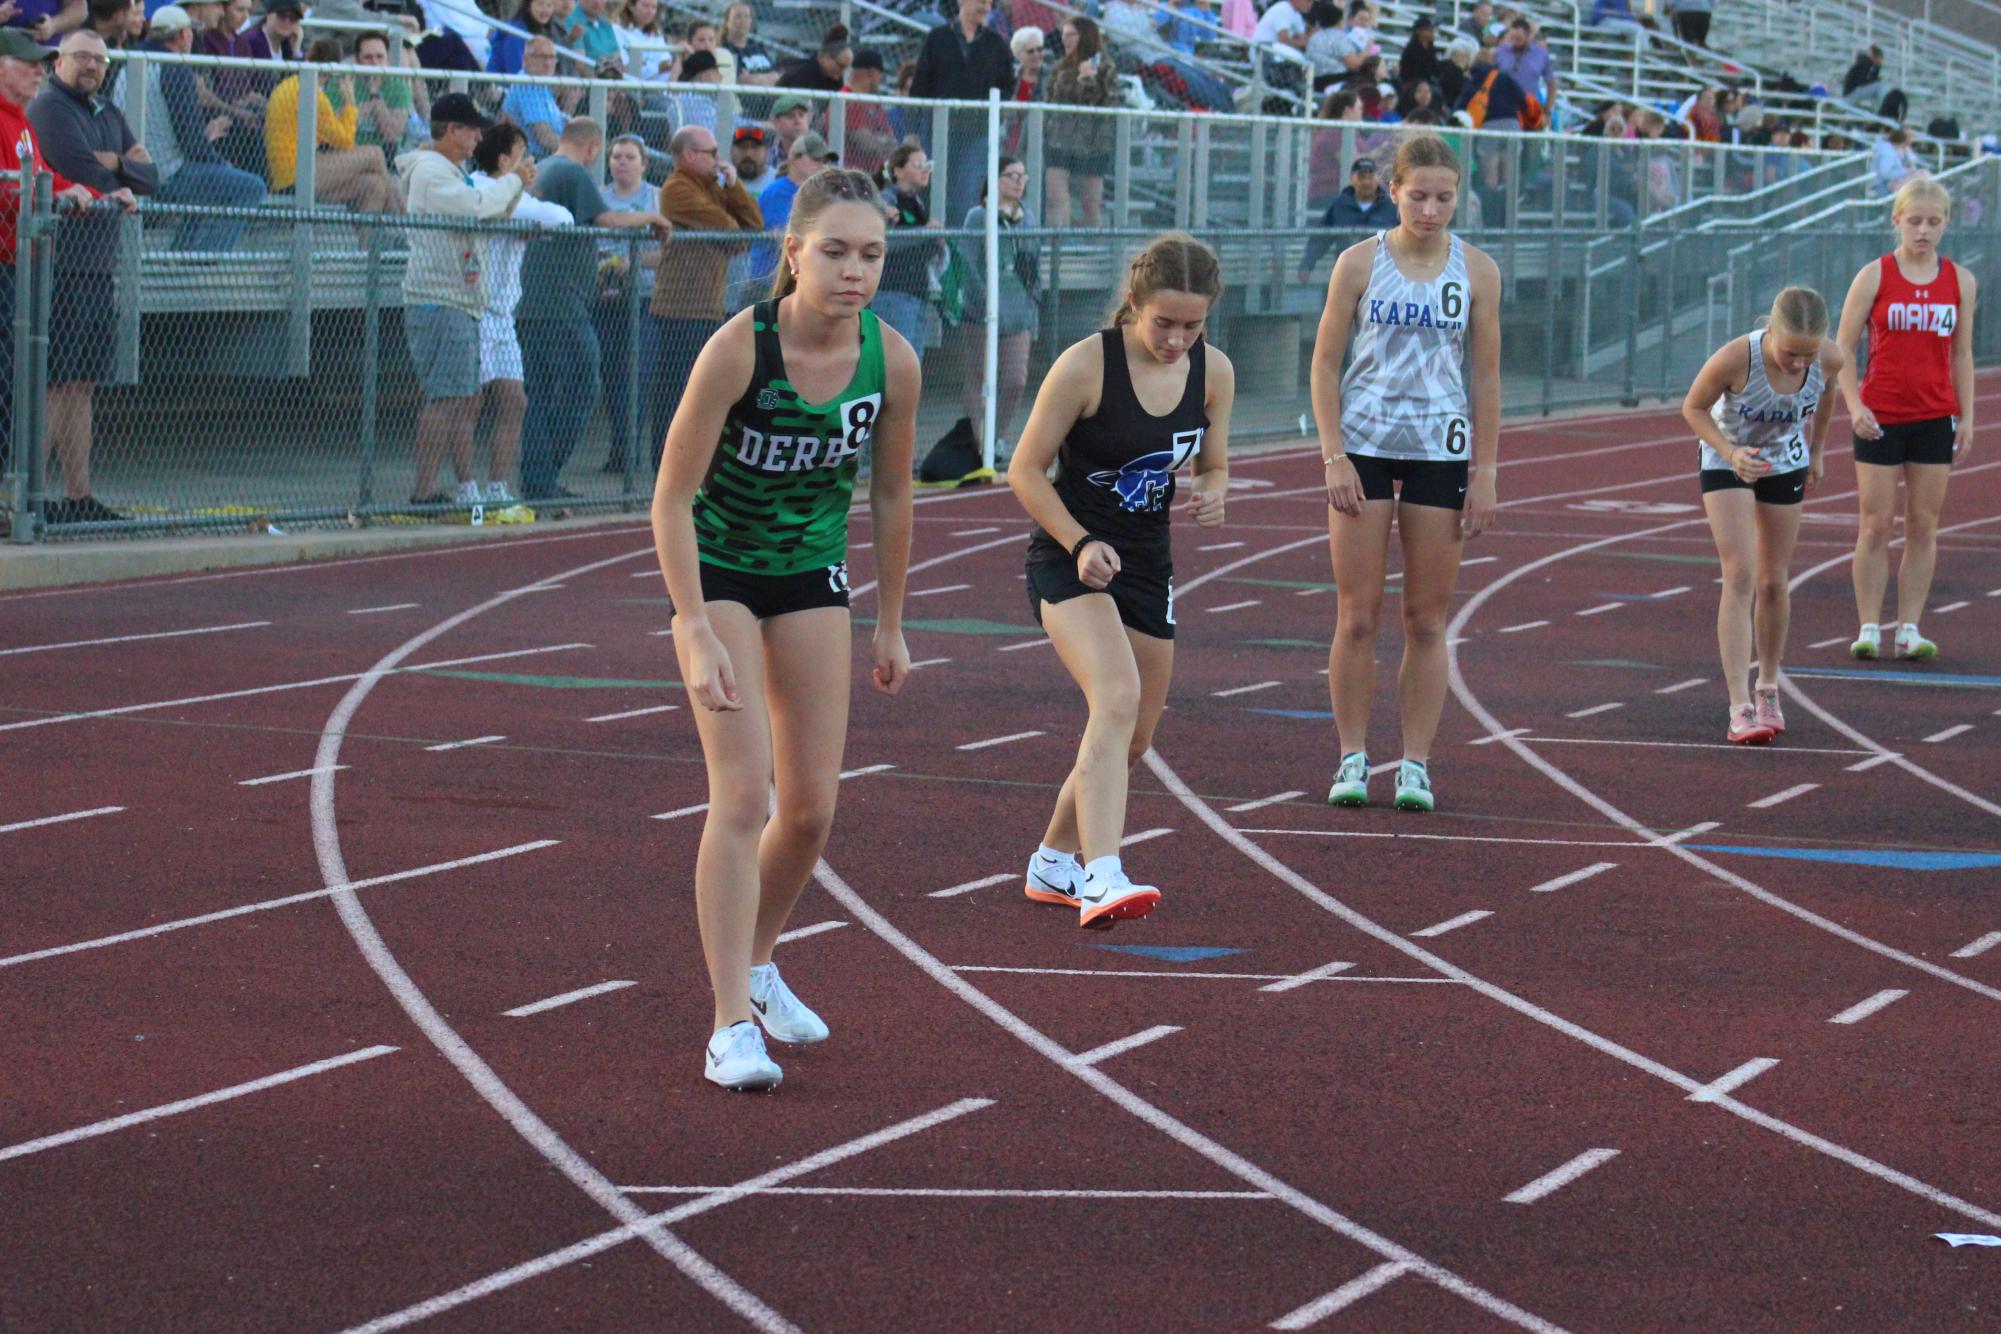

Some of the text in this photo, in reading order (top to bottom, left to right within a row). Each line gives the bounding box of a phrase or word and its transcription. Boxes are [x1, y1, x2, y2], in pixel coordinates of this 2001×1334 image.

[1441, 281, 1462, 319] 6
[1888, 303, 1940, 332] MAIZ
[1941, 306, 1954, 334] 4
[847, 400, 875, 450] 8
[1739, 404, 1796, 423] KAPA
[736, 425, 846, 472] DERB
[1176, 433, 1198, 471] 7
[1446, 417, 1467, 455] 6
[1788, 431, 1803, 462] 5
